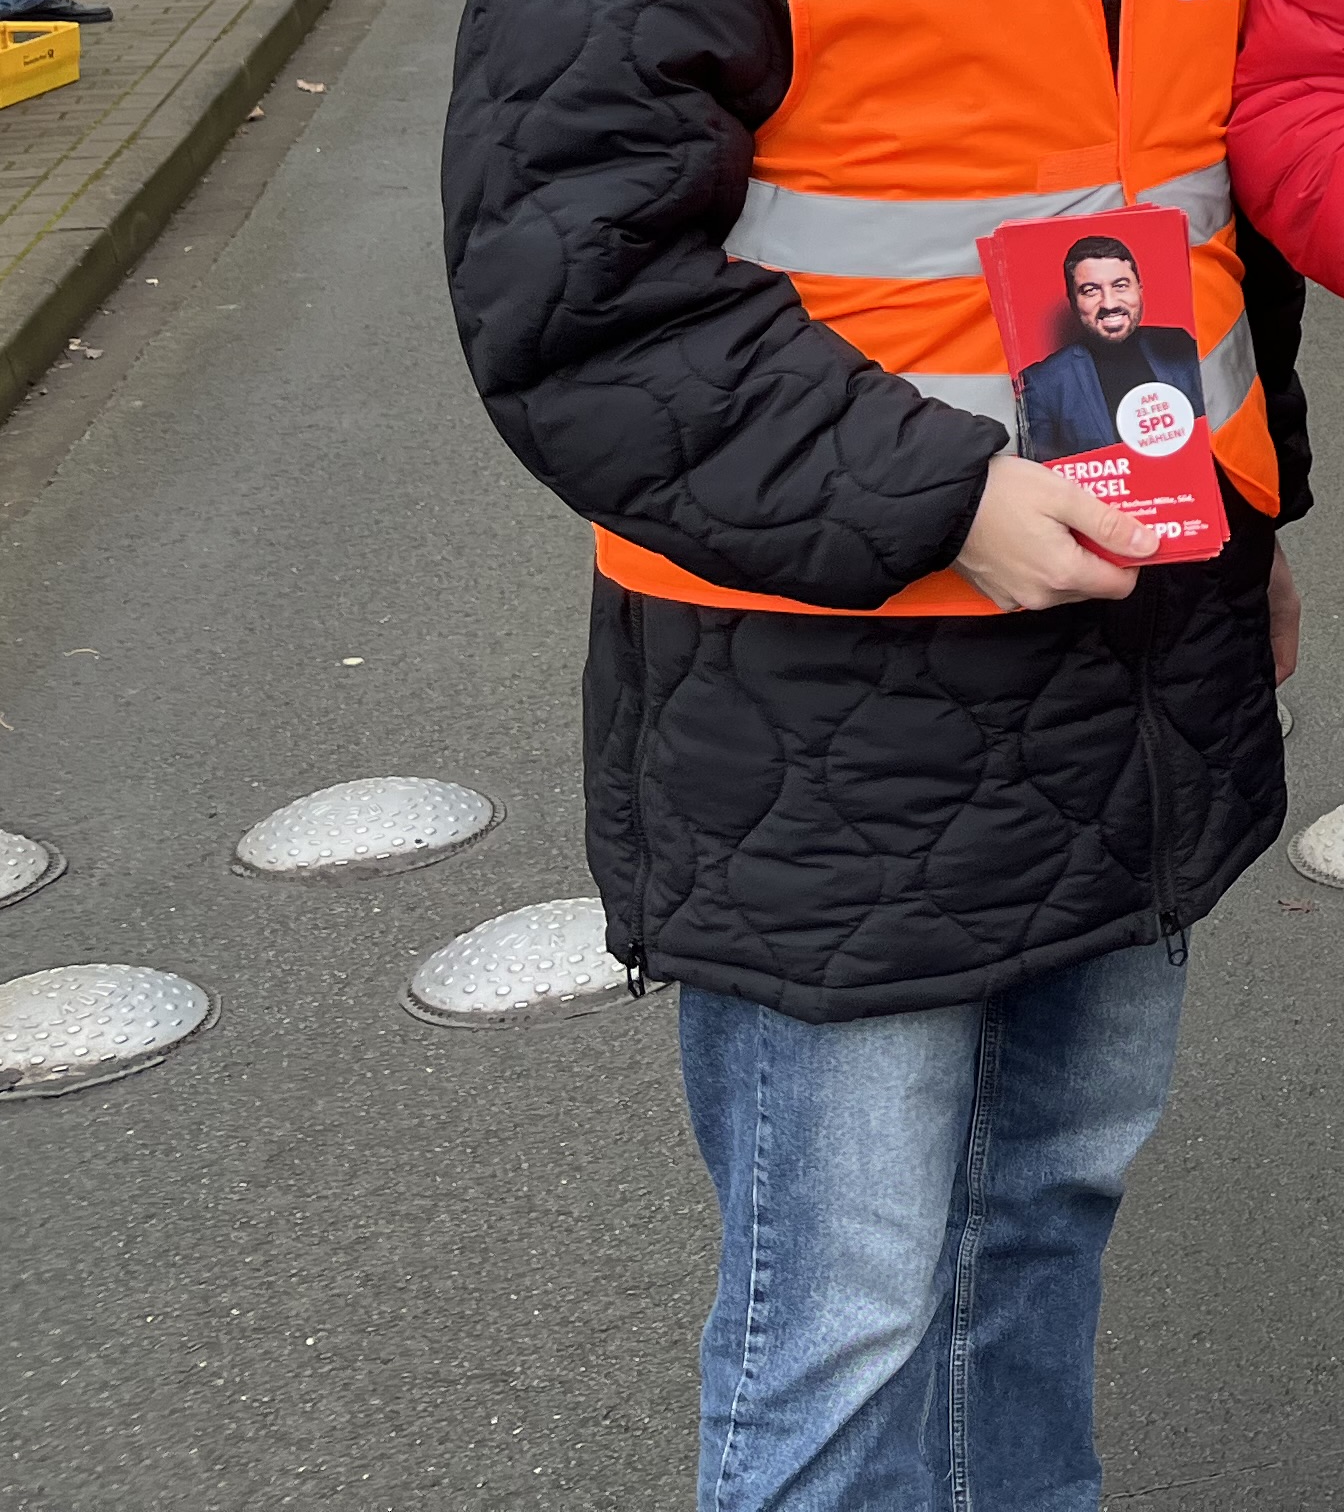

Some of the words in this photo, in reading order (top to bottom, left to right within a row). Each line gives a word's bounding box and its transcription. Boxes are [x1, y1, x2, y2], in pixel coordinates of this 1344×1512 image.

[1141, 393, 1159, 404] AM
[1151, 402, 1169, 413] FEB
[1139, 413, 1175, 434] SPD
[1138, 428, 1185, 448] WÄHLEN!
[1052, 458, 1131, 480] SERDAR
